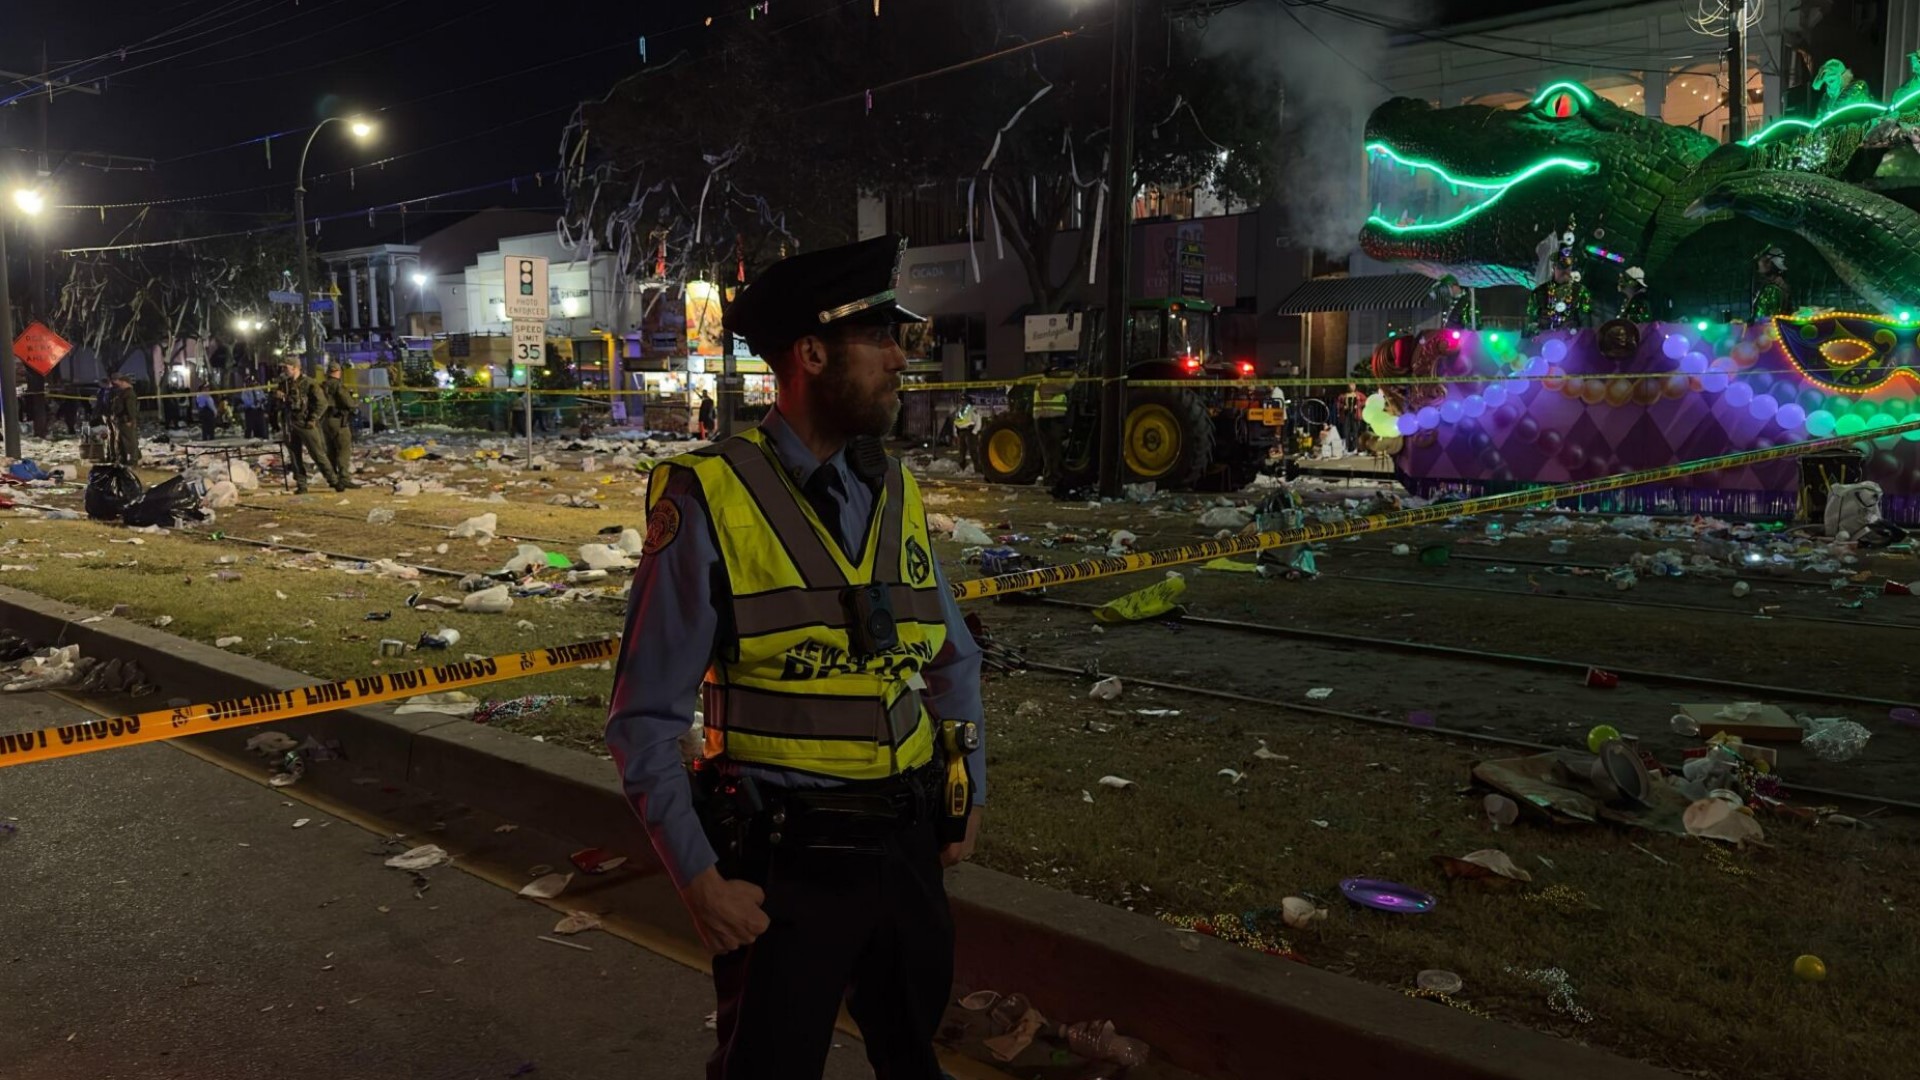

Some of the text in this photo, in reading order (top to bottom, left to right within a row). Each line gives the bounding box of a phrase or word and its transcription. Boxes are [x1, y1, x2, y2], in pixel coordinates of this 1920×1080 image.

[515, 325, 542, 333] SPEED
[517, 334, 539, 342] LIMIT
[517, 343, 541, 361] 35
